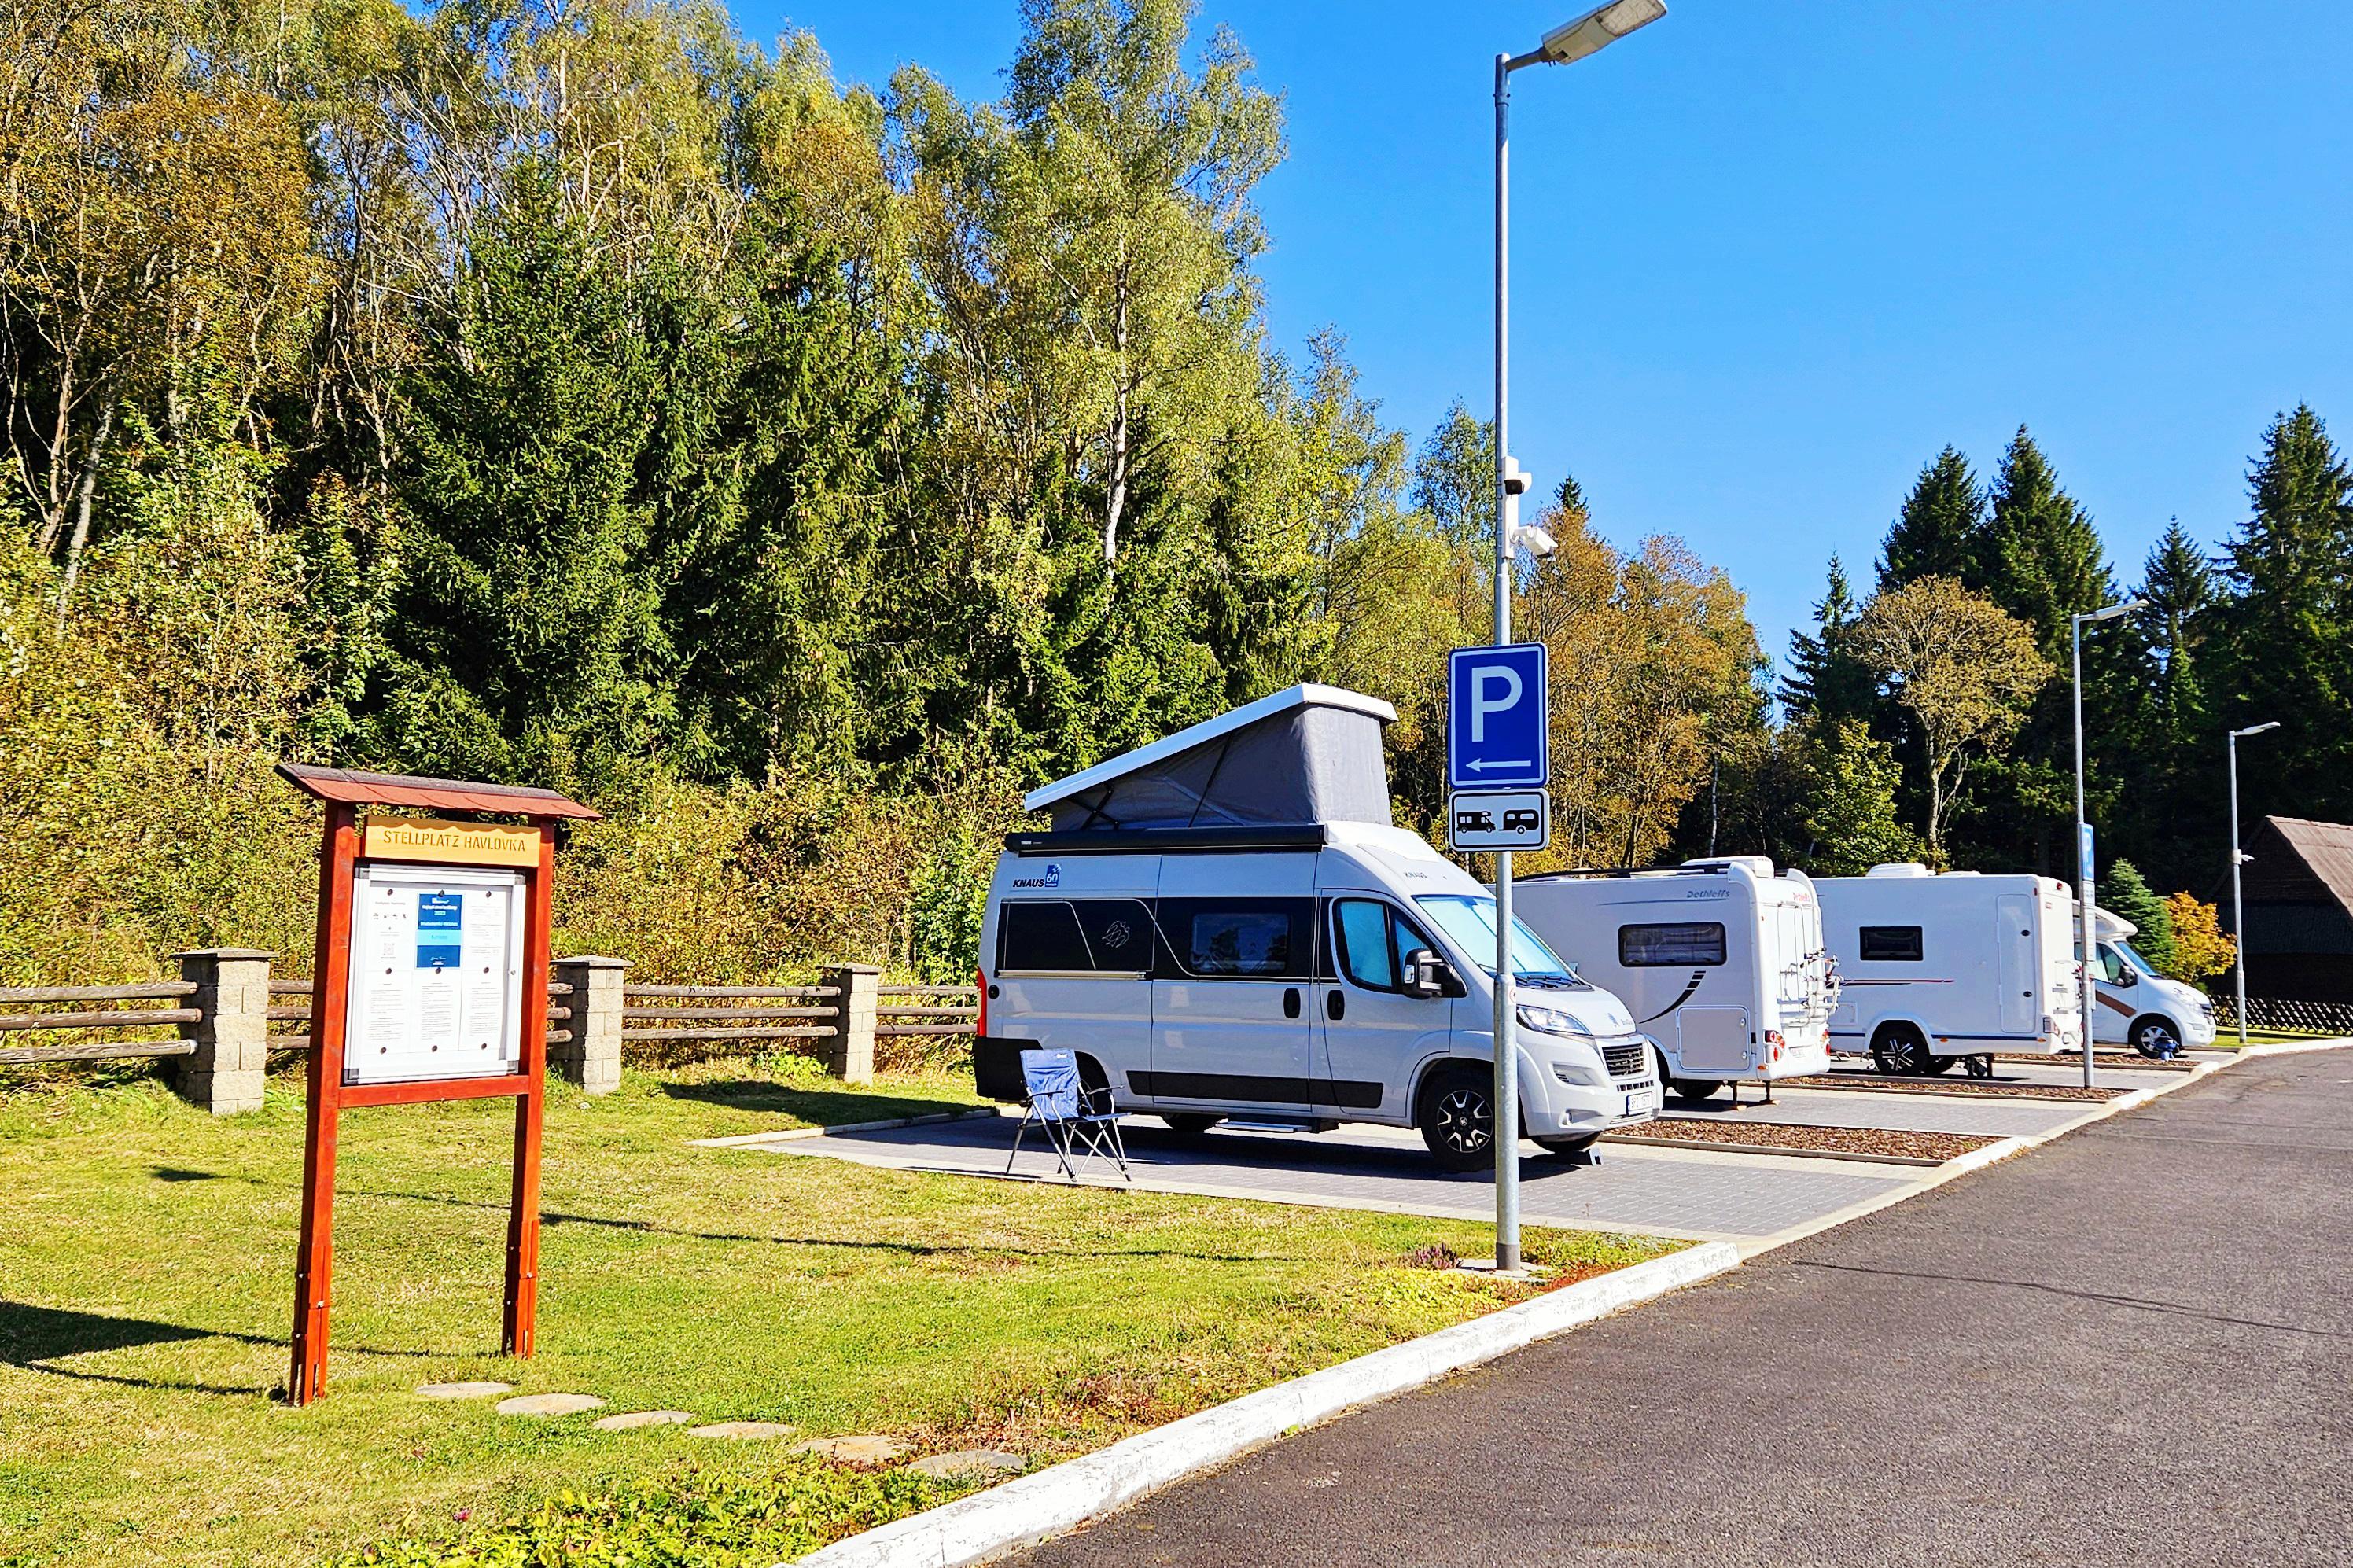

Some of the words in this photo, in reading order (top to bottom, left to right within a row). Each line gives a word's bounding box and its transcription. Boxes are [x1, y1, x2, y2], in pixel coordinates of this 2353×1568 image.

[1471, 666, 1521, 742] P
[384, 830, 459, 848] STELLPLATZ
[464, 836, 525, 852] HAVLOVKA
[1013, 878, 1044, 887] KNAUS
[1047, 873, 1058, 883] 60
[1687, 889, 1730, 898] Dethleffs
